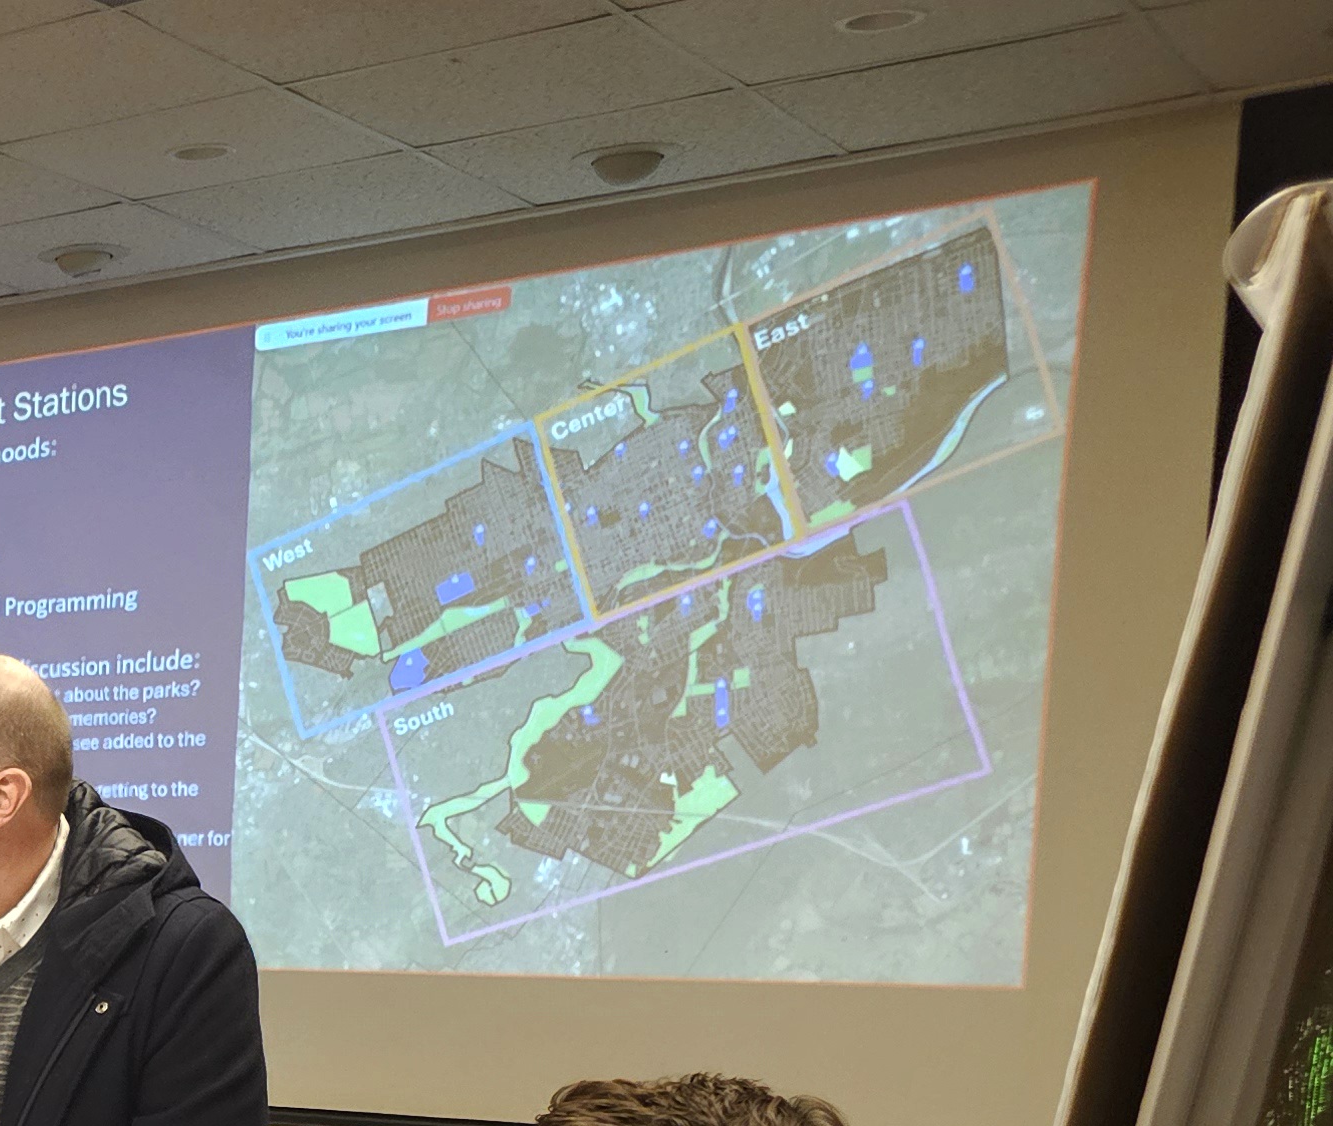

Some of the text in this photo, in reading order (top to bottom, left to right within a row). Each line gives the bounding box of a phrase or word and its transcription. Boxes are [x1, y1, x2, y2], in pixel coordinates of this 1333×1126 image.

[285, 312, 412, 340] You're sharing your screen
[753, 312, 811, 351] East
[13, 383, 128, 421] Stations
[551, 396, 626, 441] Center
[262, 539, 313, 572] West
[5, 588, 138, 619] Programming
[117, 648, 201, 674] include:
[63, 679, 201, 703] about the parks?
[70, 708, 157, 727] memories?
[393, 701, 454, 736] South
[72, 731, 206, 751] see added to the
[150, 782, 168, 798] to
[171, 780, 199, 797] the
[207, 830, 231, 847] for
